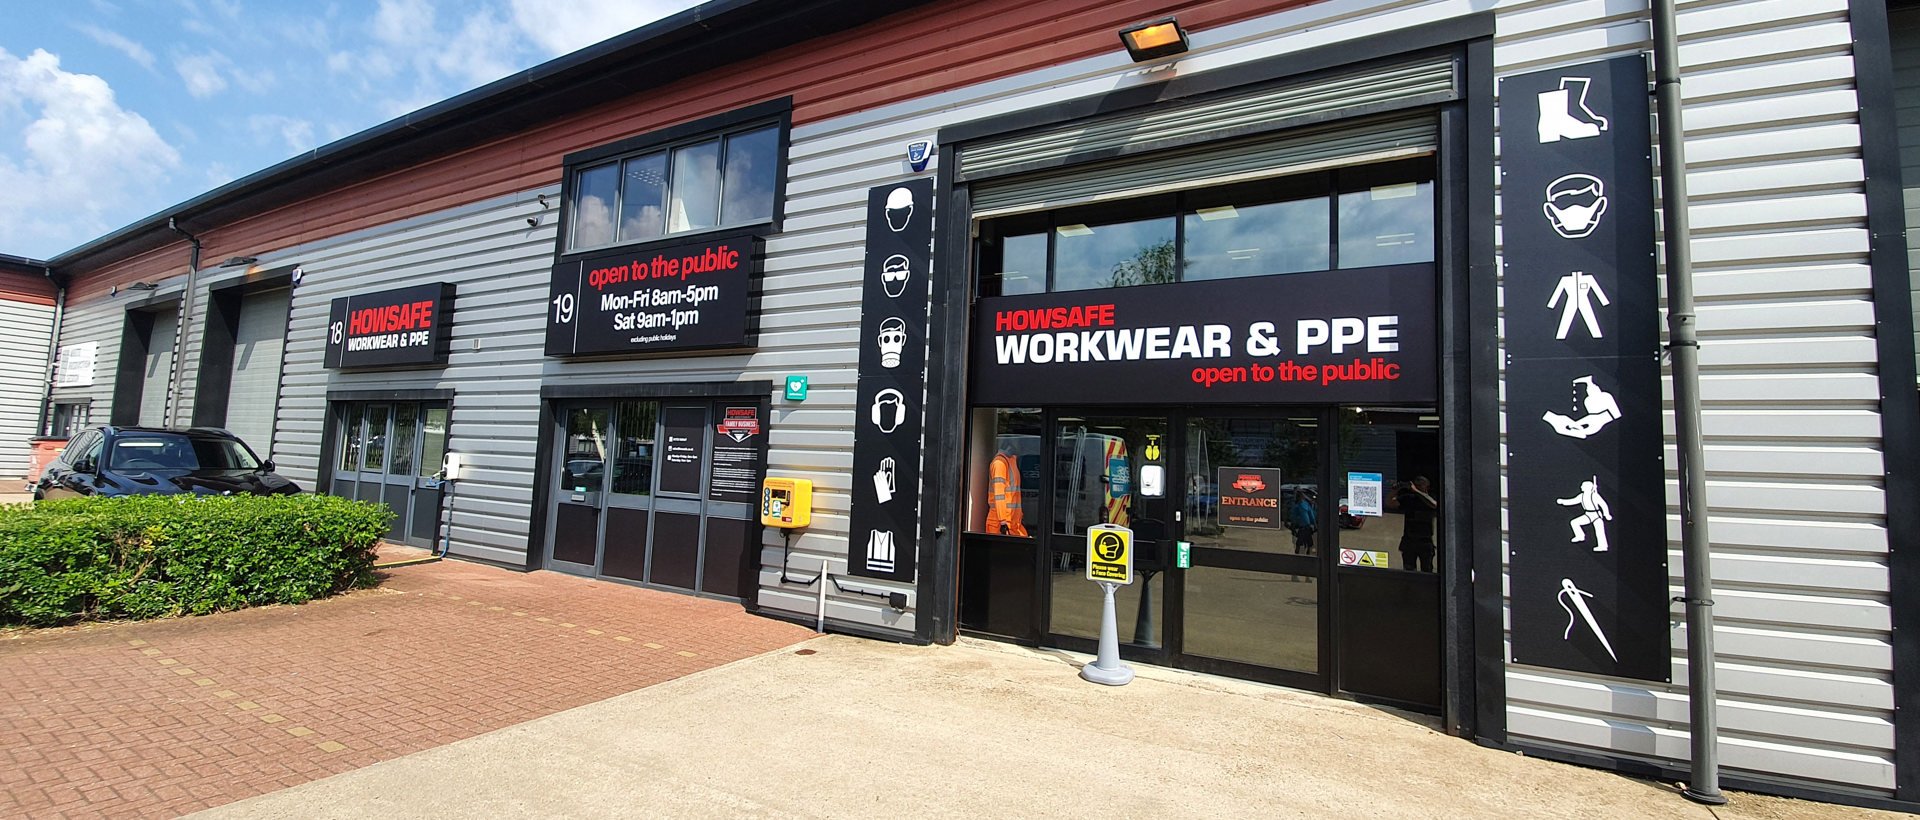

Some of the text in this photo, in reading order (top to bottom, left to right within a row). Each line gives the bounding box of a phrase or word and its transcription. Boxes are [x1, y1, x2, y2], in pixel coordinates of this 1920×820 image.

[589, 245, 739, 290] open to the public
[553, 293, 574, 324] 19
[601, 284, 718, 311] Mon-Fri 8am-5pm
[349, 300, 434, 335] HOWSAFE
[613, 309, 699, 330] Sat 9am-1pm
[995, 303, 1115, 331] HOWSAFE
[330, 321, 343, 345] 18
[348, 331, 429, 351] WORKWEAR & PPE
[648, 334, 660, 343] public
[660, 333, 676, 342] holidays
[995, 315, 1399, 365] WORKWEAR & PPE
[1192, 357, 1400, 387] open to the public
[1221, 496, 1277, 507] ENTRANCE
